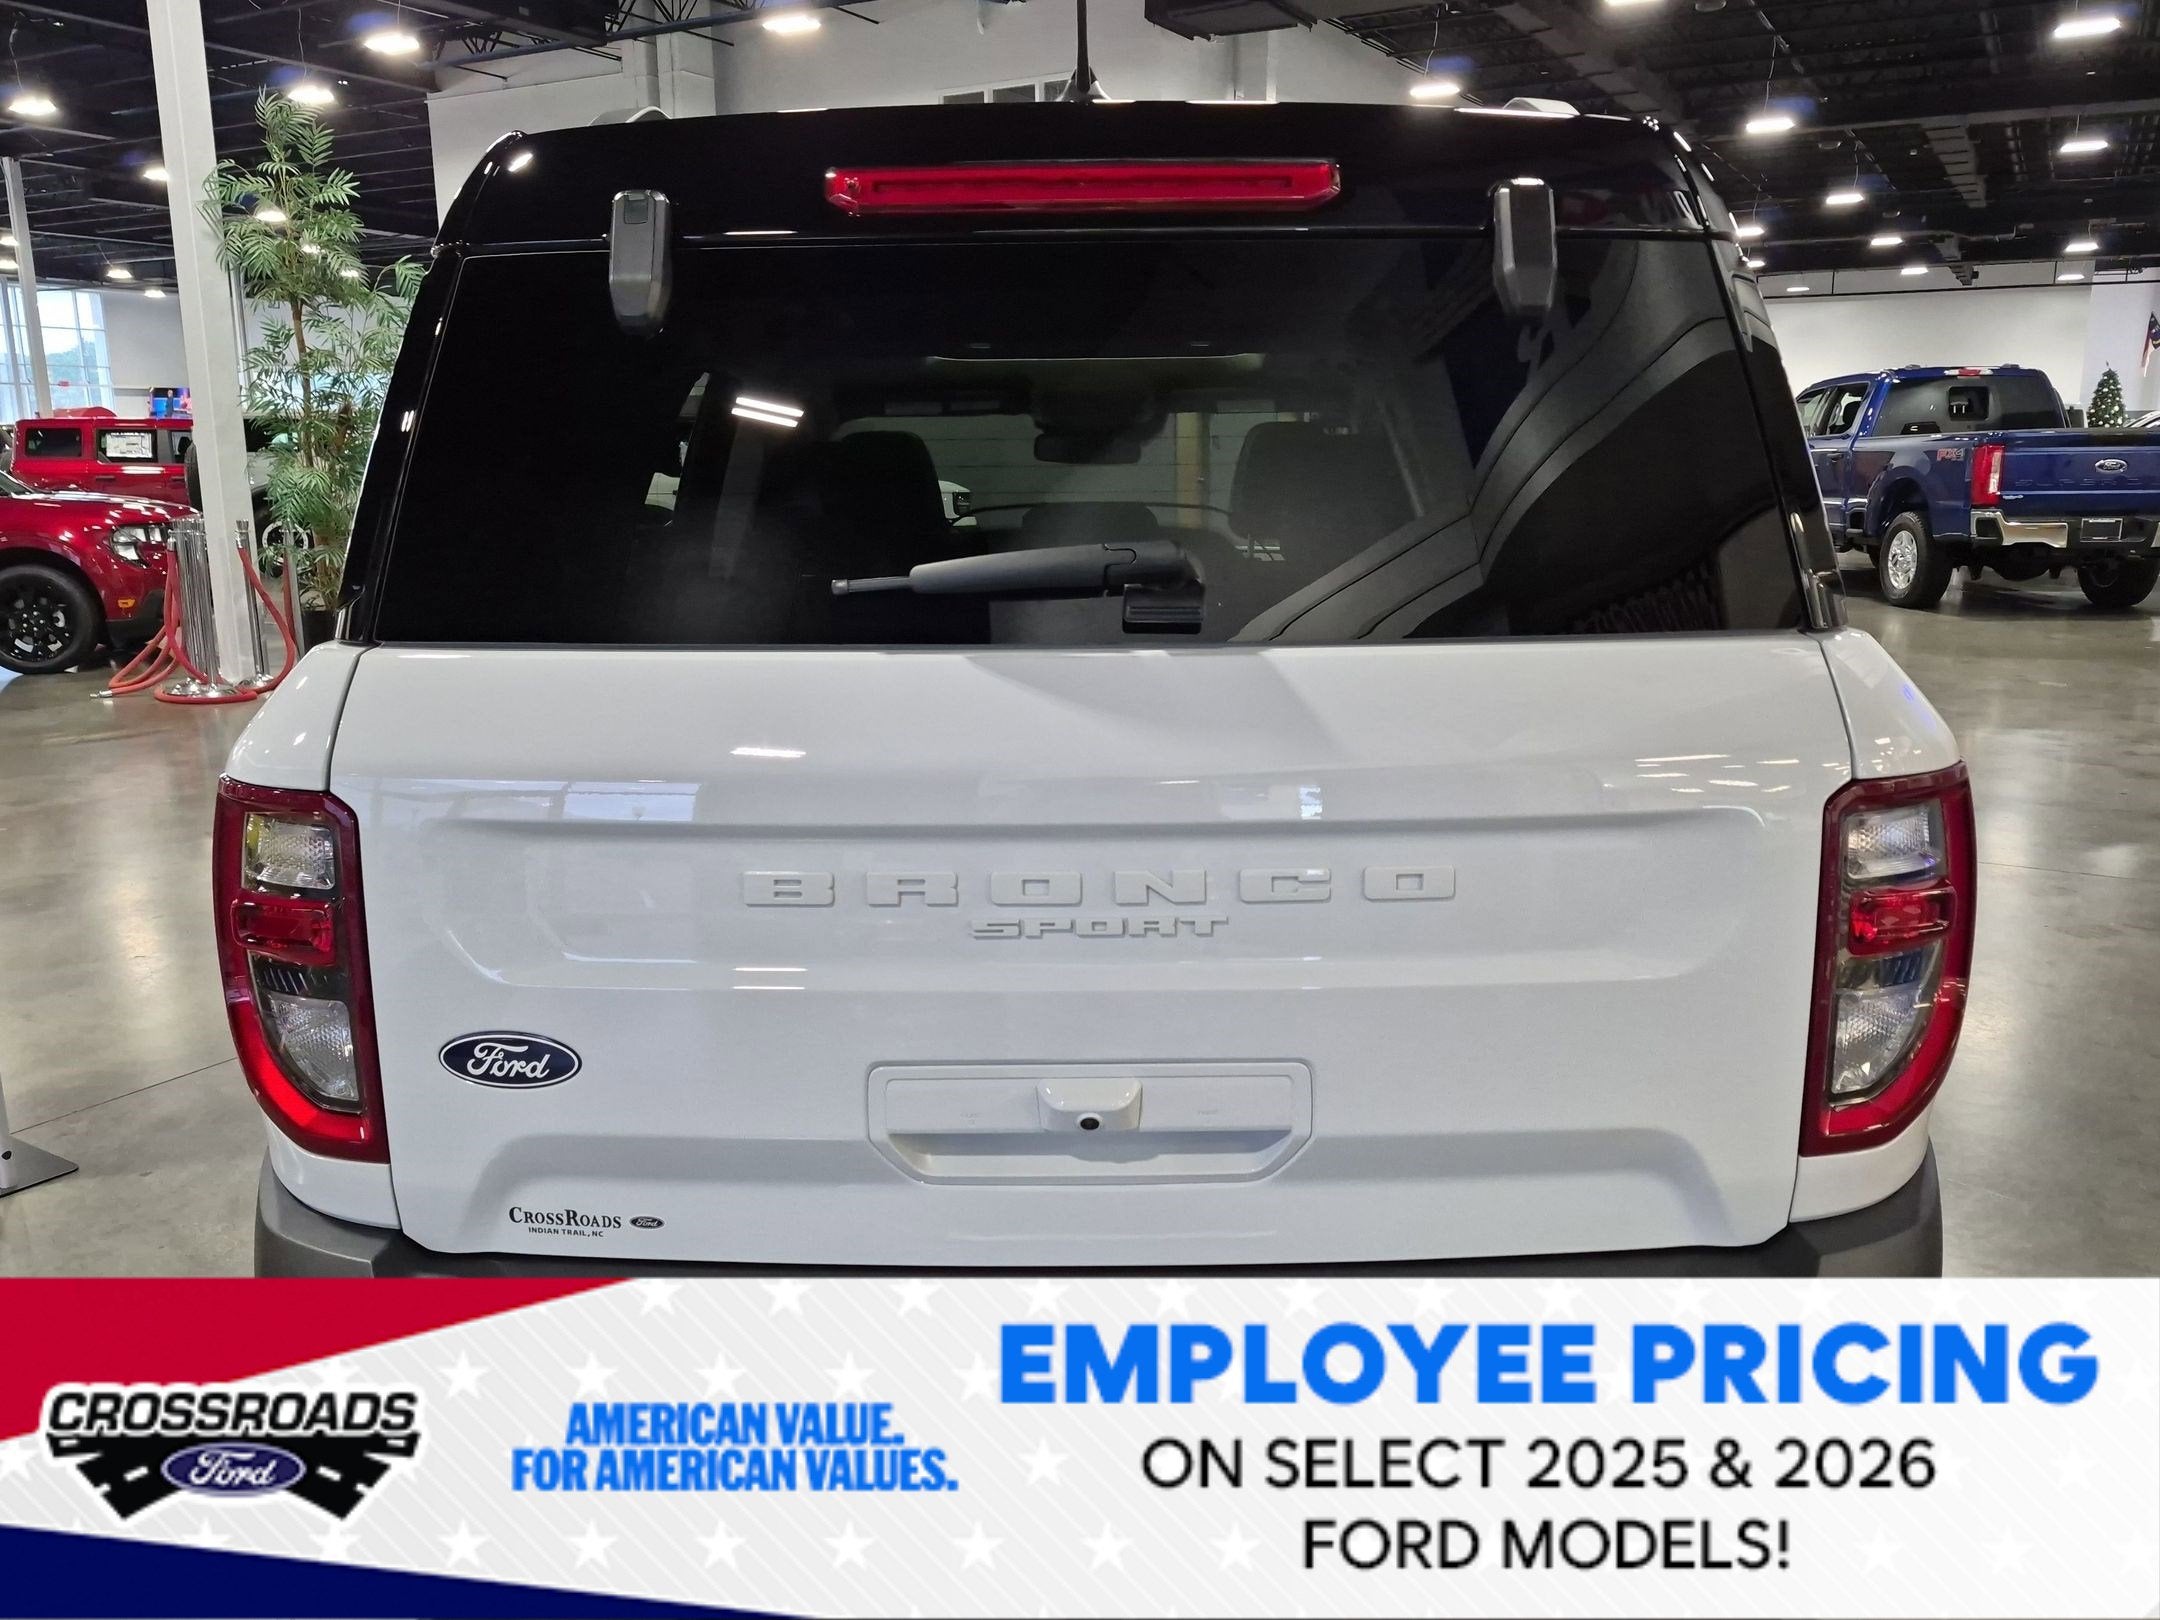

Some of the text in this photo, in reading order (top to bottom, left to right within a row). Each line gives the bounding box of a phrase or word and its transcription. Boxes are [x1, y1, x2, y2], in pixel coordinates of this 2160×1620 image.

[743, 865, 1456, 907] BRONCO
[970, 916, 1229, 938] SPORT
[466, 1042, 551, 1079] Ford
[528, 1226, 559, 1235] INDIAN
